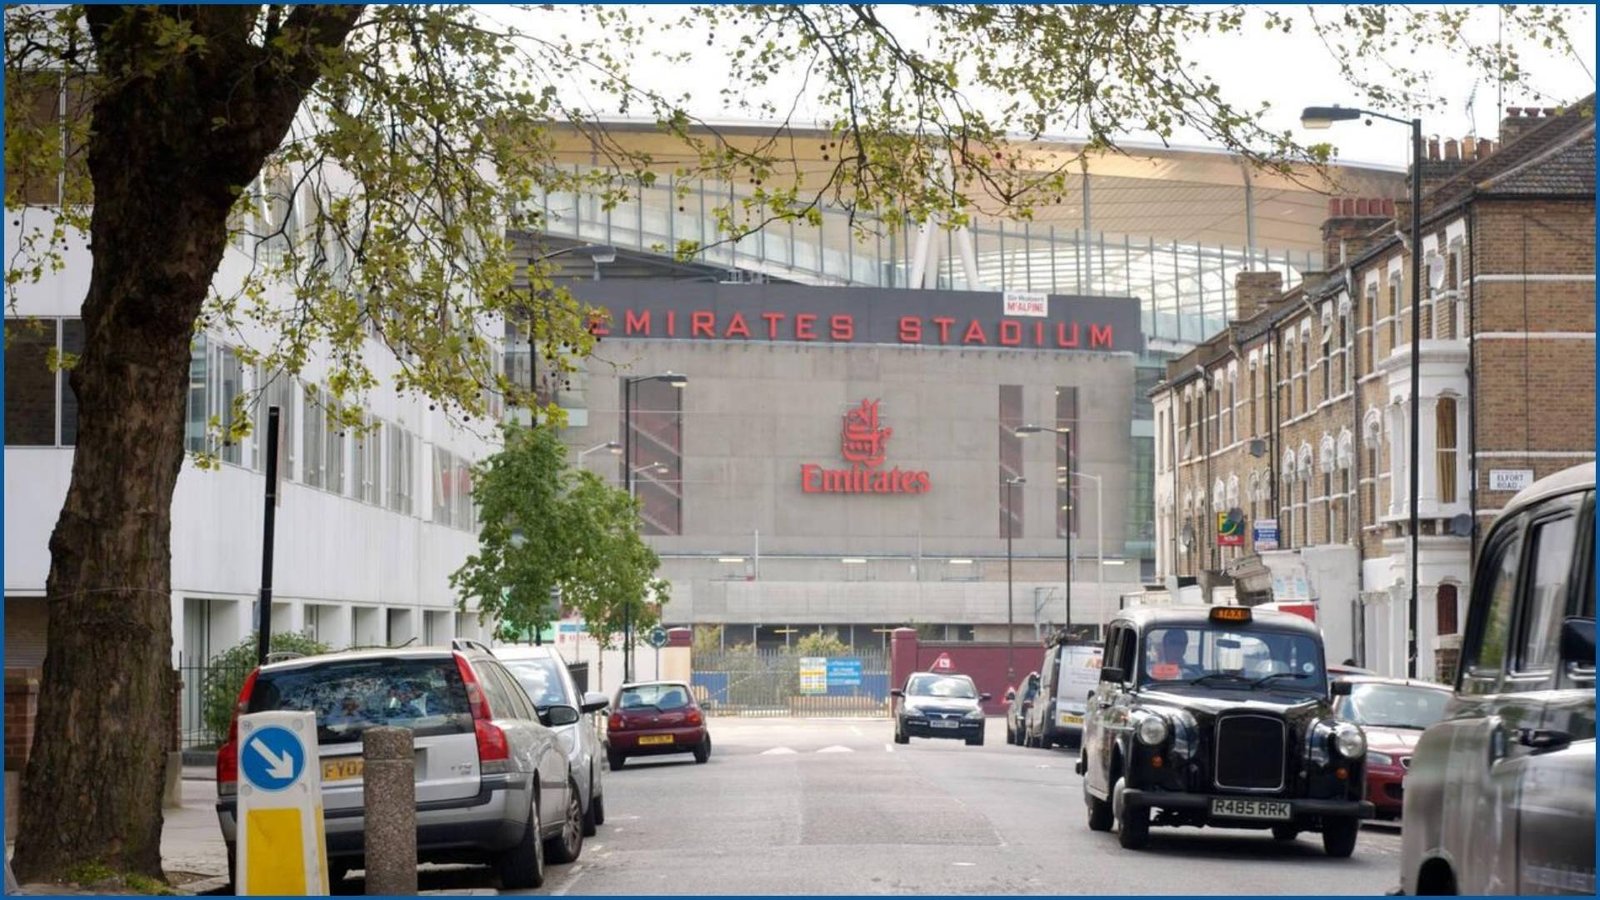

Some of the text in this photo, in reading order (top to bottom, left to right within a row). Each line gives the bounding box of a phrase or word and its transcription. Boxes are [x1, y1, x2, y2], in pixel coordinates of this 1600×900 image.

[899, 317, 1113, 349] STADIUM
[800, 463, 932, 494] Emirates
[1496, 474, 1524, 482] ELFORT
[1214, 800, 1288, 817] R485 RRK
